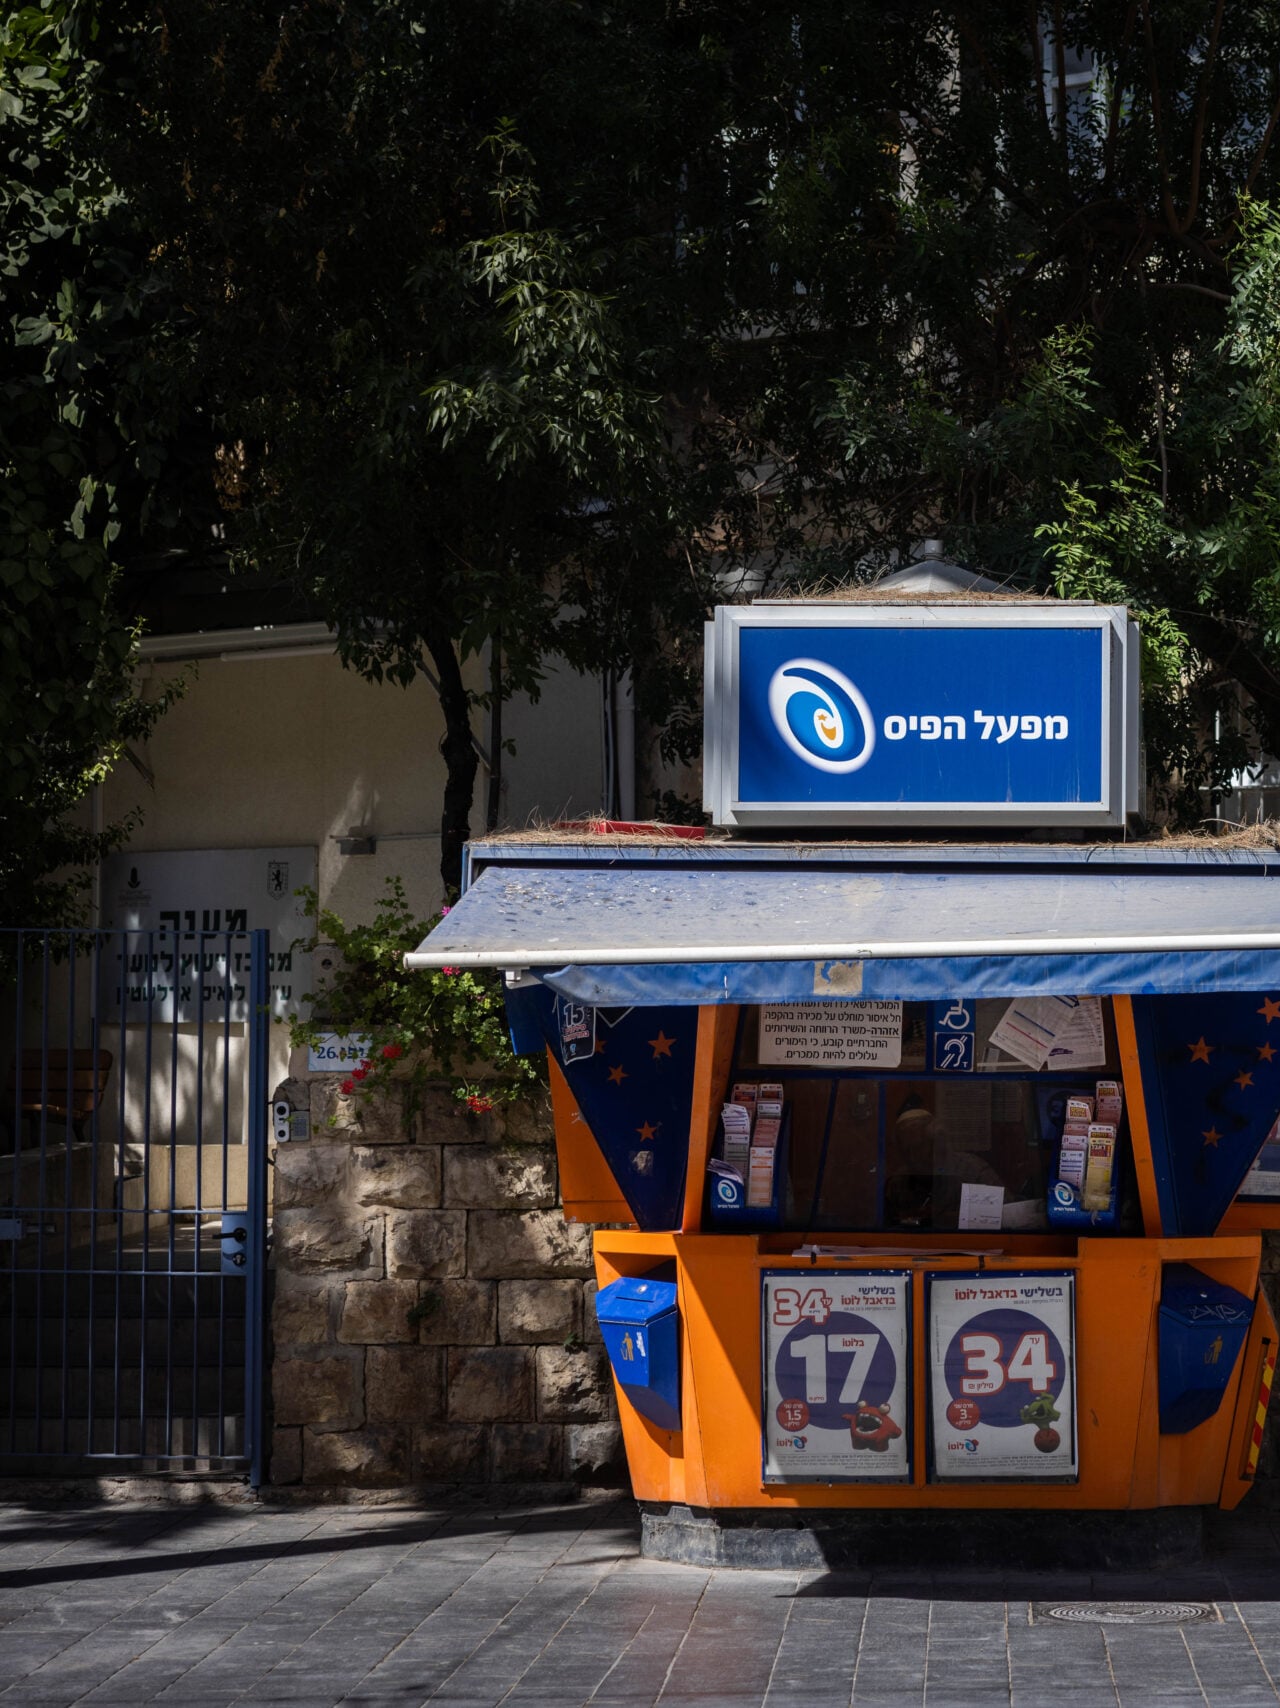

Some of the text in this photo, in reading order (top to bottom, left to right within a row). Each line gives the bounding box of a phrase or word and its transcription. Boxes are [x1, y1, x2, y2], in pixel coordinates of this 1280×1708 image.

[883, 709, 1069, 744] מפעל הפיס
[160, 909, 247, 940] מענה
[874, 1001, 900, 1010] המוכר
[797, 1012, 823, 1021] מכירה
[824, 1010, 836, 1021] על
[838, 1011, 865, 1022] מוחלט
[866, 1014, 889, 1022] איסור
[889, 1012, 901, 1022] חל
[765, 1024, 807, 1033] והשירותים
[809, 1025, 839, 1034] הרווחה
[775, 1037, 808, 1046] הימורים
[810, 1038, 819, 1046] כי
[846, 1039, 888, 1048] החברתיים
[317, 1047, 336, 1059] 26
[822, 1050, 846, 1060] להיות
[848, 1050, 878, 1061] עלולים
[858, 1285, 896, 1295] בשלישי
[979, 1288, 1018, 1299] בדאבל
[1020, 1286, 1063, 1298] בשלישי
[863, 1295, 896, 1305] בדאבל
[773, 1288, 832, 1326] 34
[790, 1333, 881, 1404] 17
[960, 1331, 1056, 1395] 34
[785, 1409, 802, 1421] 1.5
[960, 1408, 968, 1420] 3
